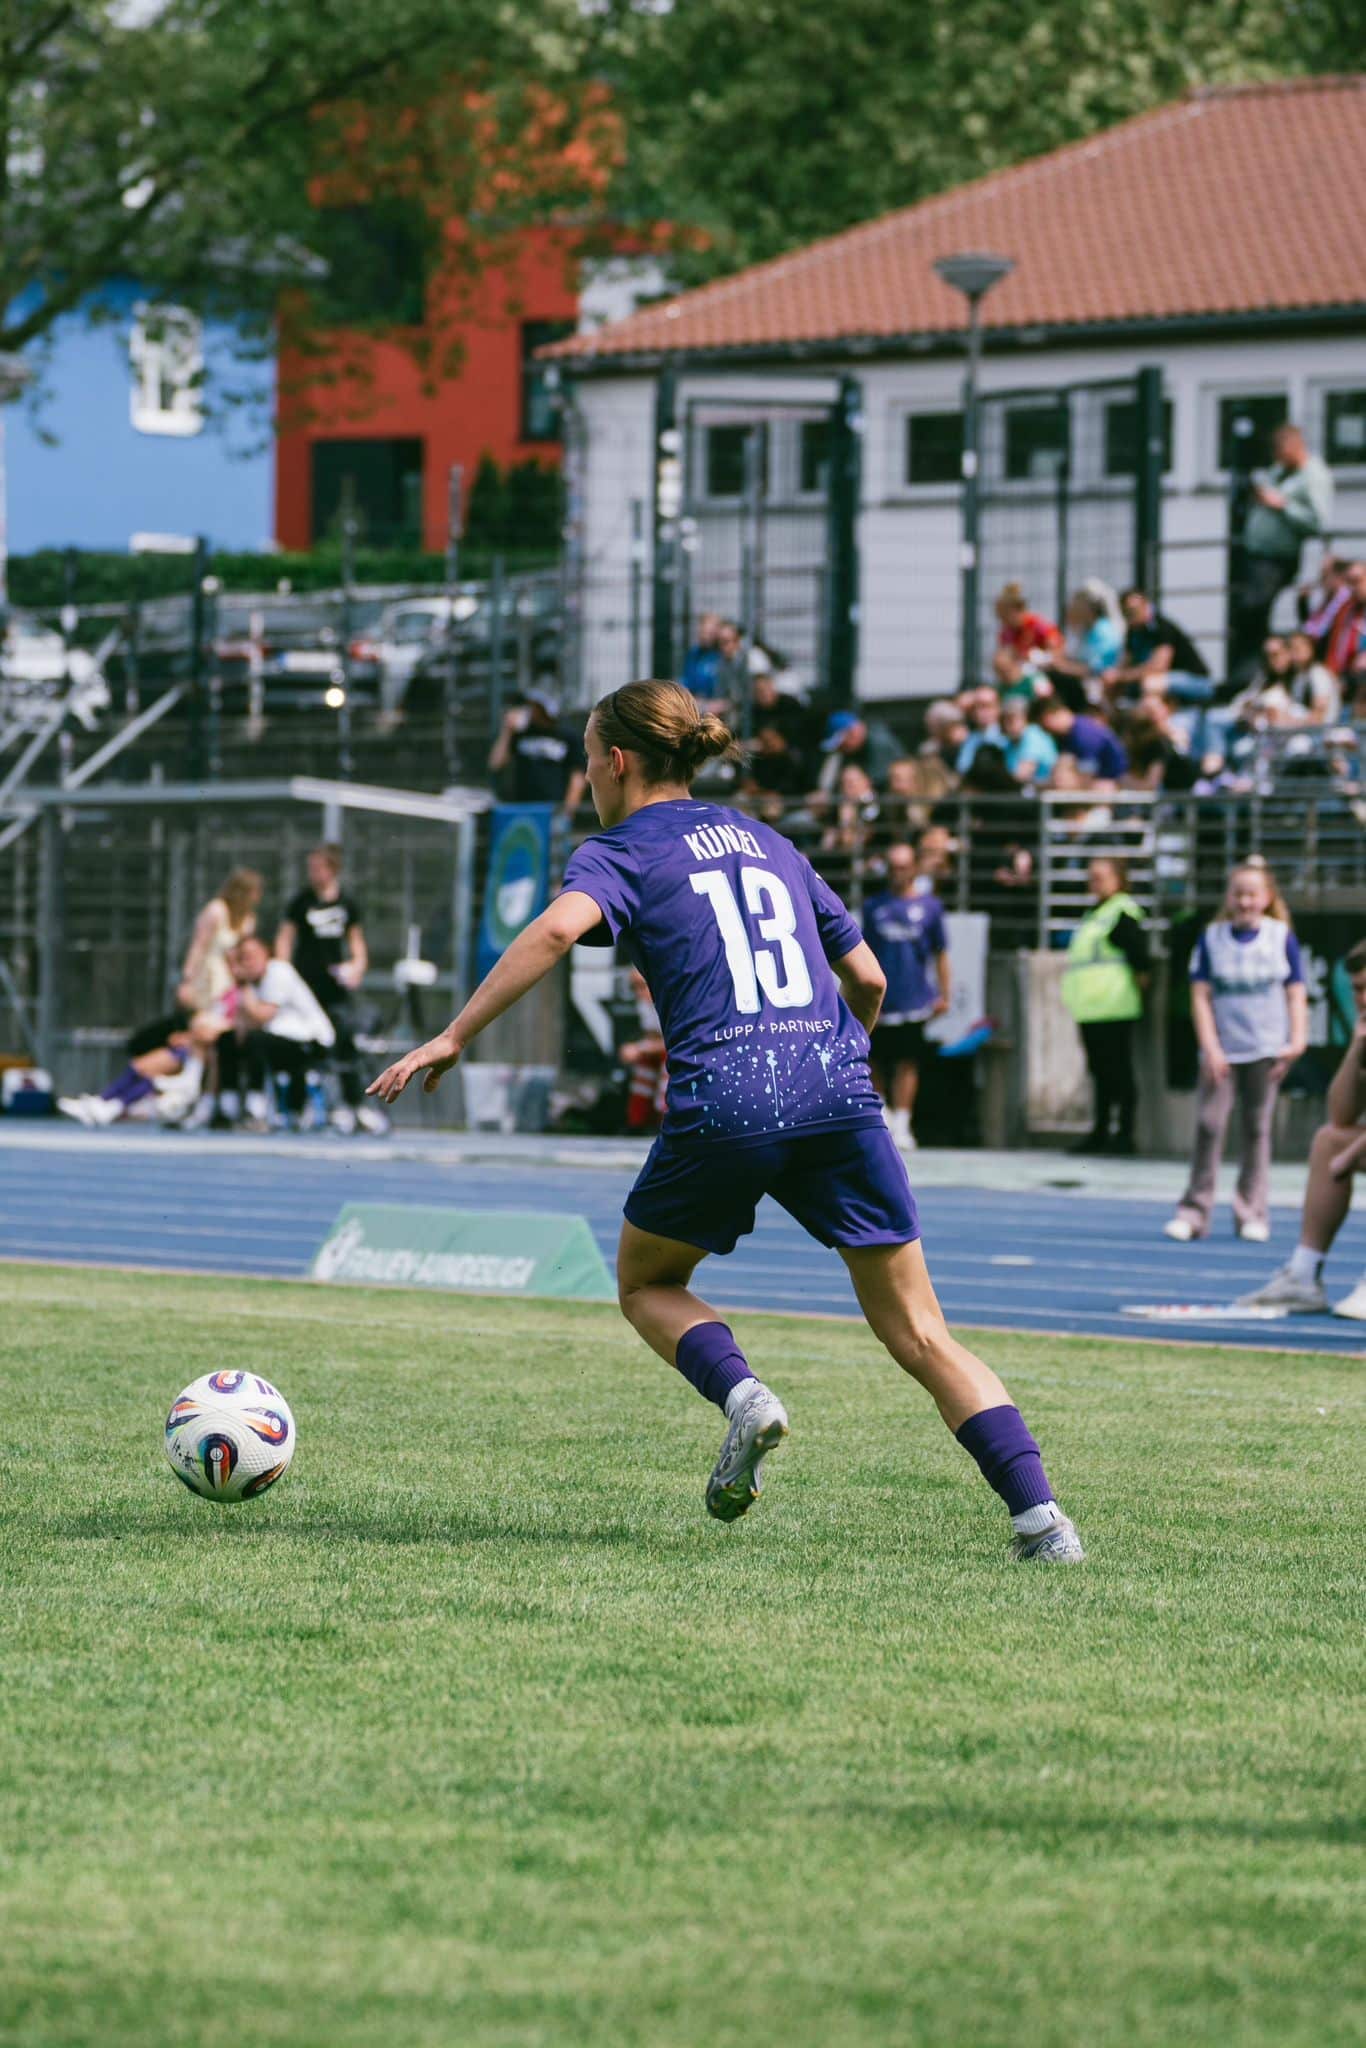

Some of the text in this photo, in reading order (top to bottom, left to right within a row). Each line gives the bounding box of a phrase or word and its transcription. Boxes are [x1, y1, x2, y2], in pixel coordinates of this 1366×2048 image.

[689, 866, 813, 1014] 13
[714, 1019, 834, 1042] LUPP + PARTNER
